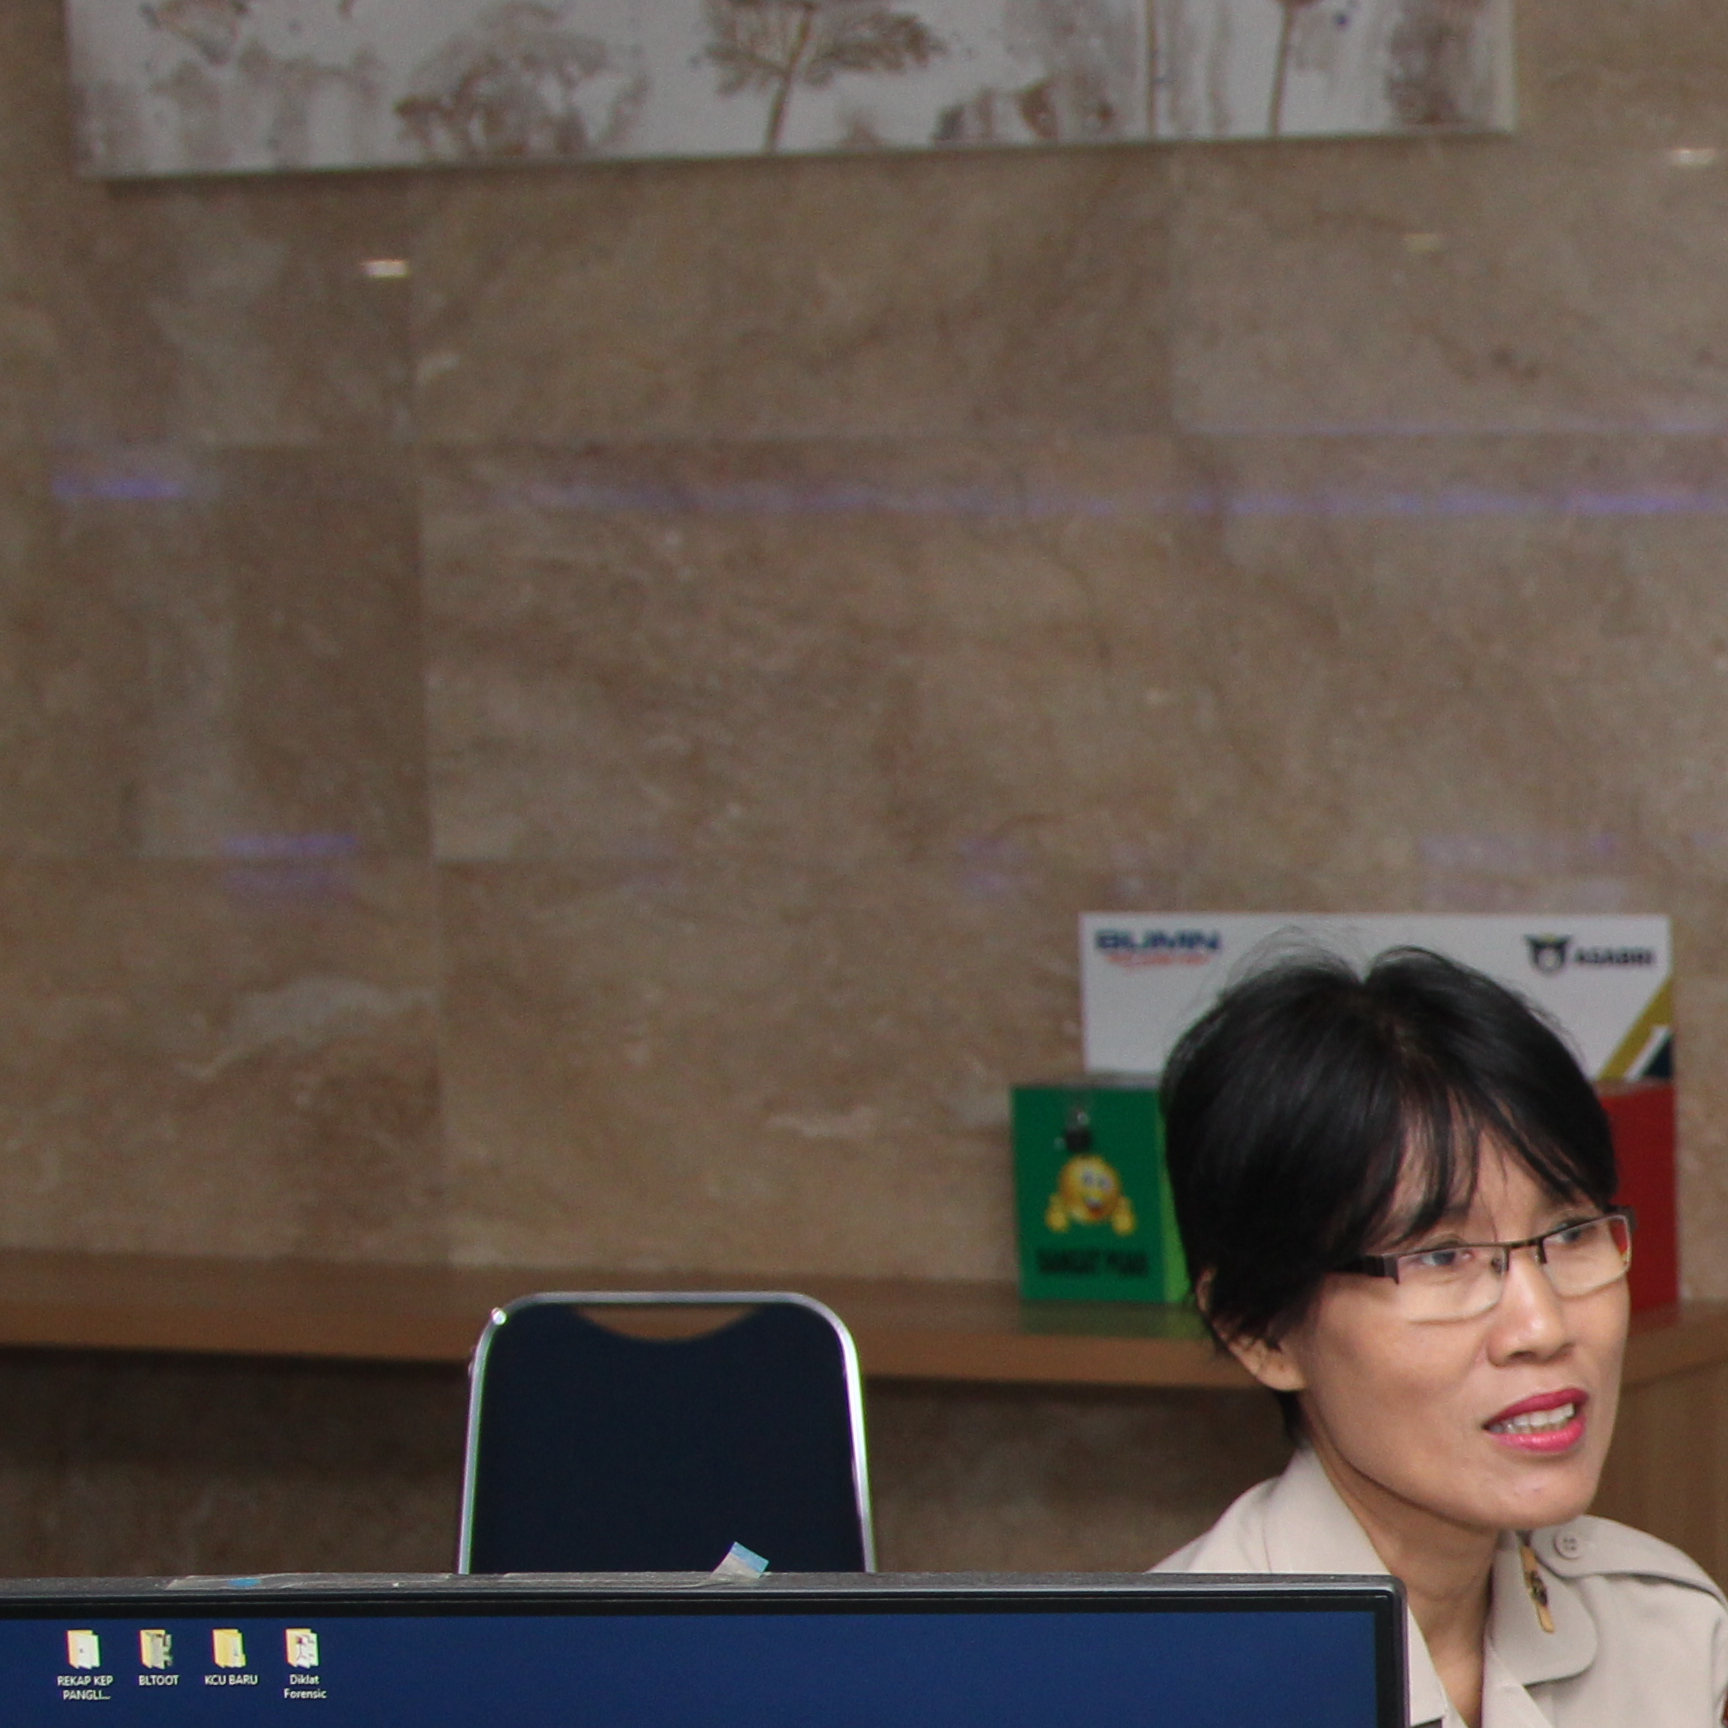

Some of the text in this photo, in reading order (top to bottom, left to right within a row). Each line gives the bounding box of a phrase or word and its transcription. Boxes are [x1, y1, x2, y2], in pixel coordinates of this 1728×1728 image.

[57, 1675, 113, 1686] REKAP KEP
[138, 1675, 179, 1686] BLTOOT
[204, 1675, 259, 1686] KCU BARU
[289, 1674, 320, 1686] Diklat
[283, 1687, 327, 1700] Forensic
